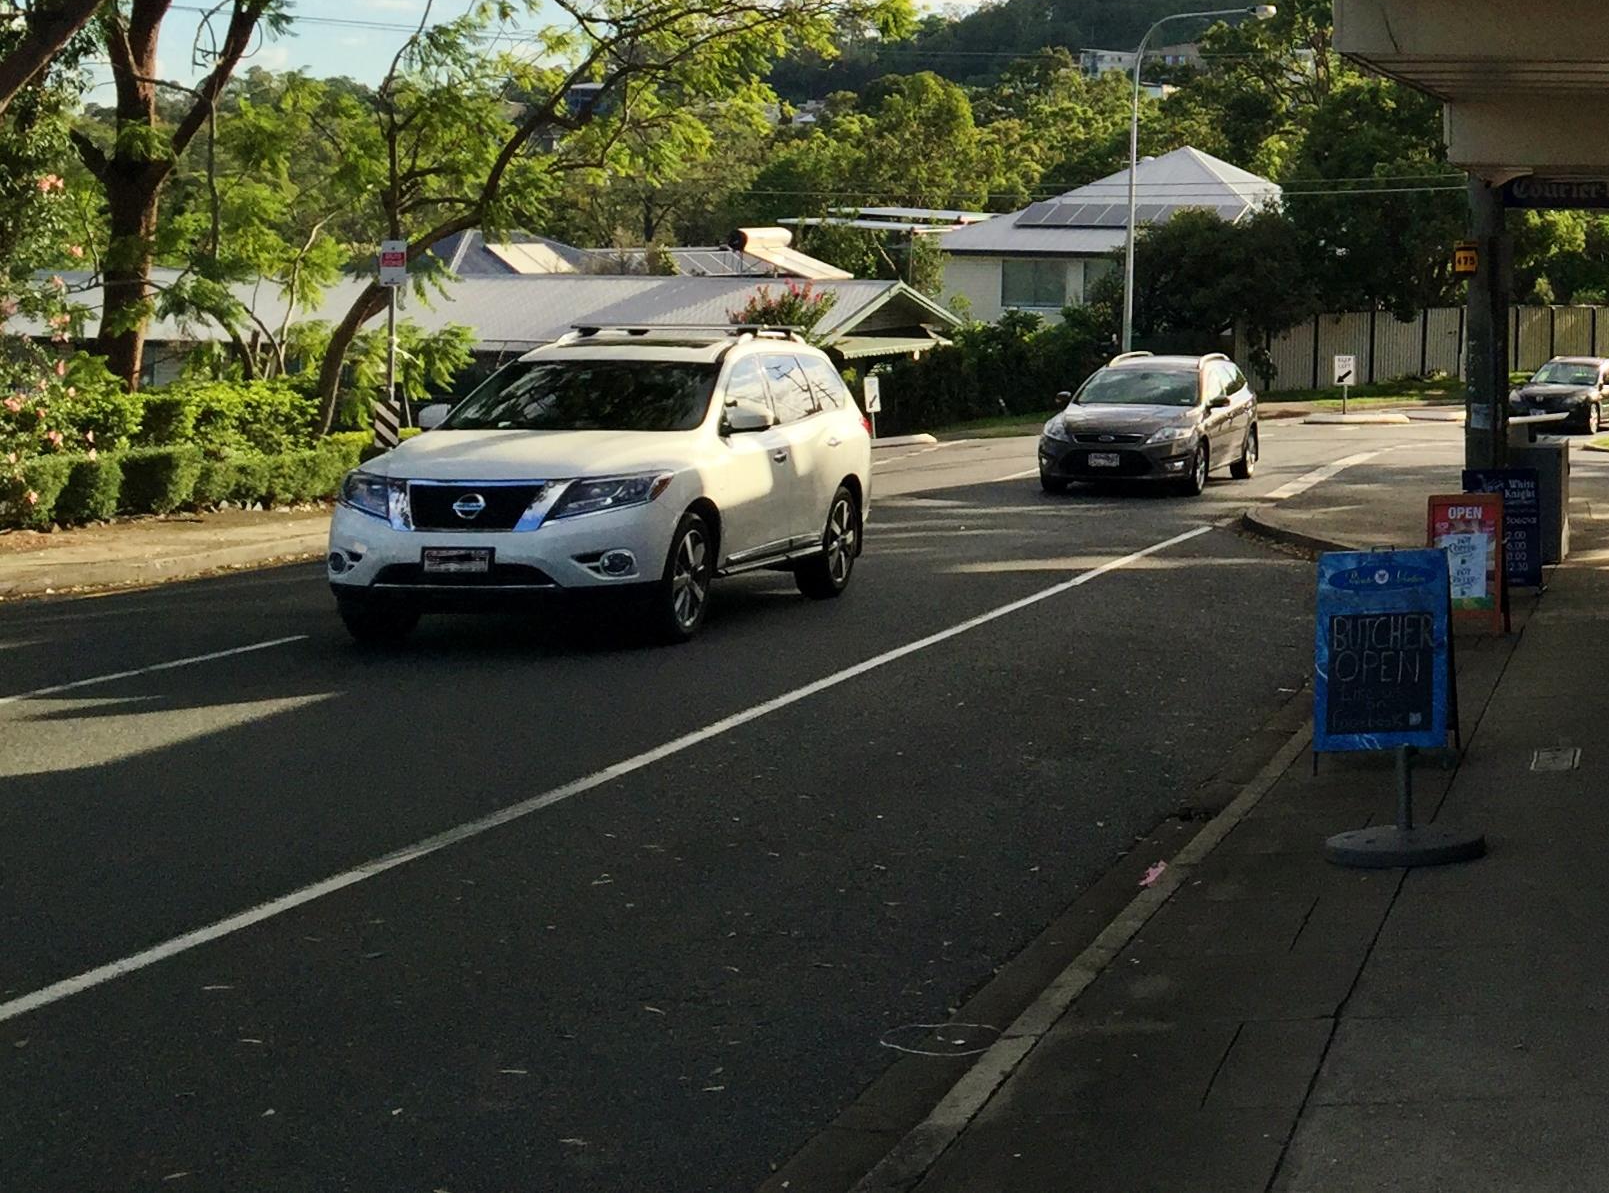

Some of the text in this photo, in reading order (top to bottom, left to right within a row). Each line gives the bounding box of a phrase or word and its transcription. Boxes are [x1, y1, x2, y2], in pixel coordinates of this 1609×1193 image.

[1508, 478, 1536, 489] White
[1504, 489, 1536, 500] Knight
[1448, 506, 1483, 519] OPEN
[1333, 614, 1435, 651] BUTCHER
[1335, 650, 1420, 683] OPEN
